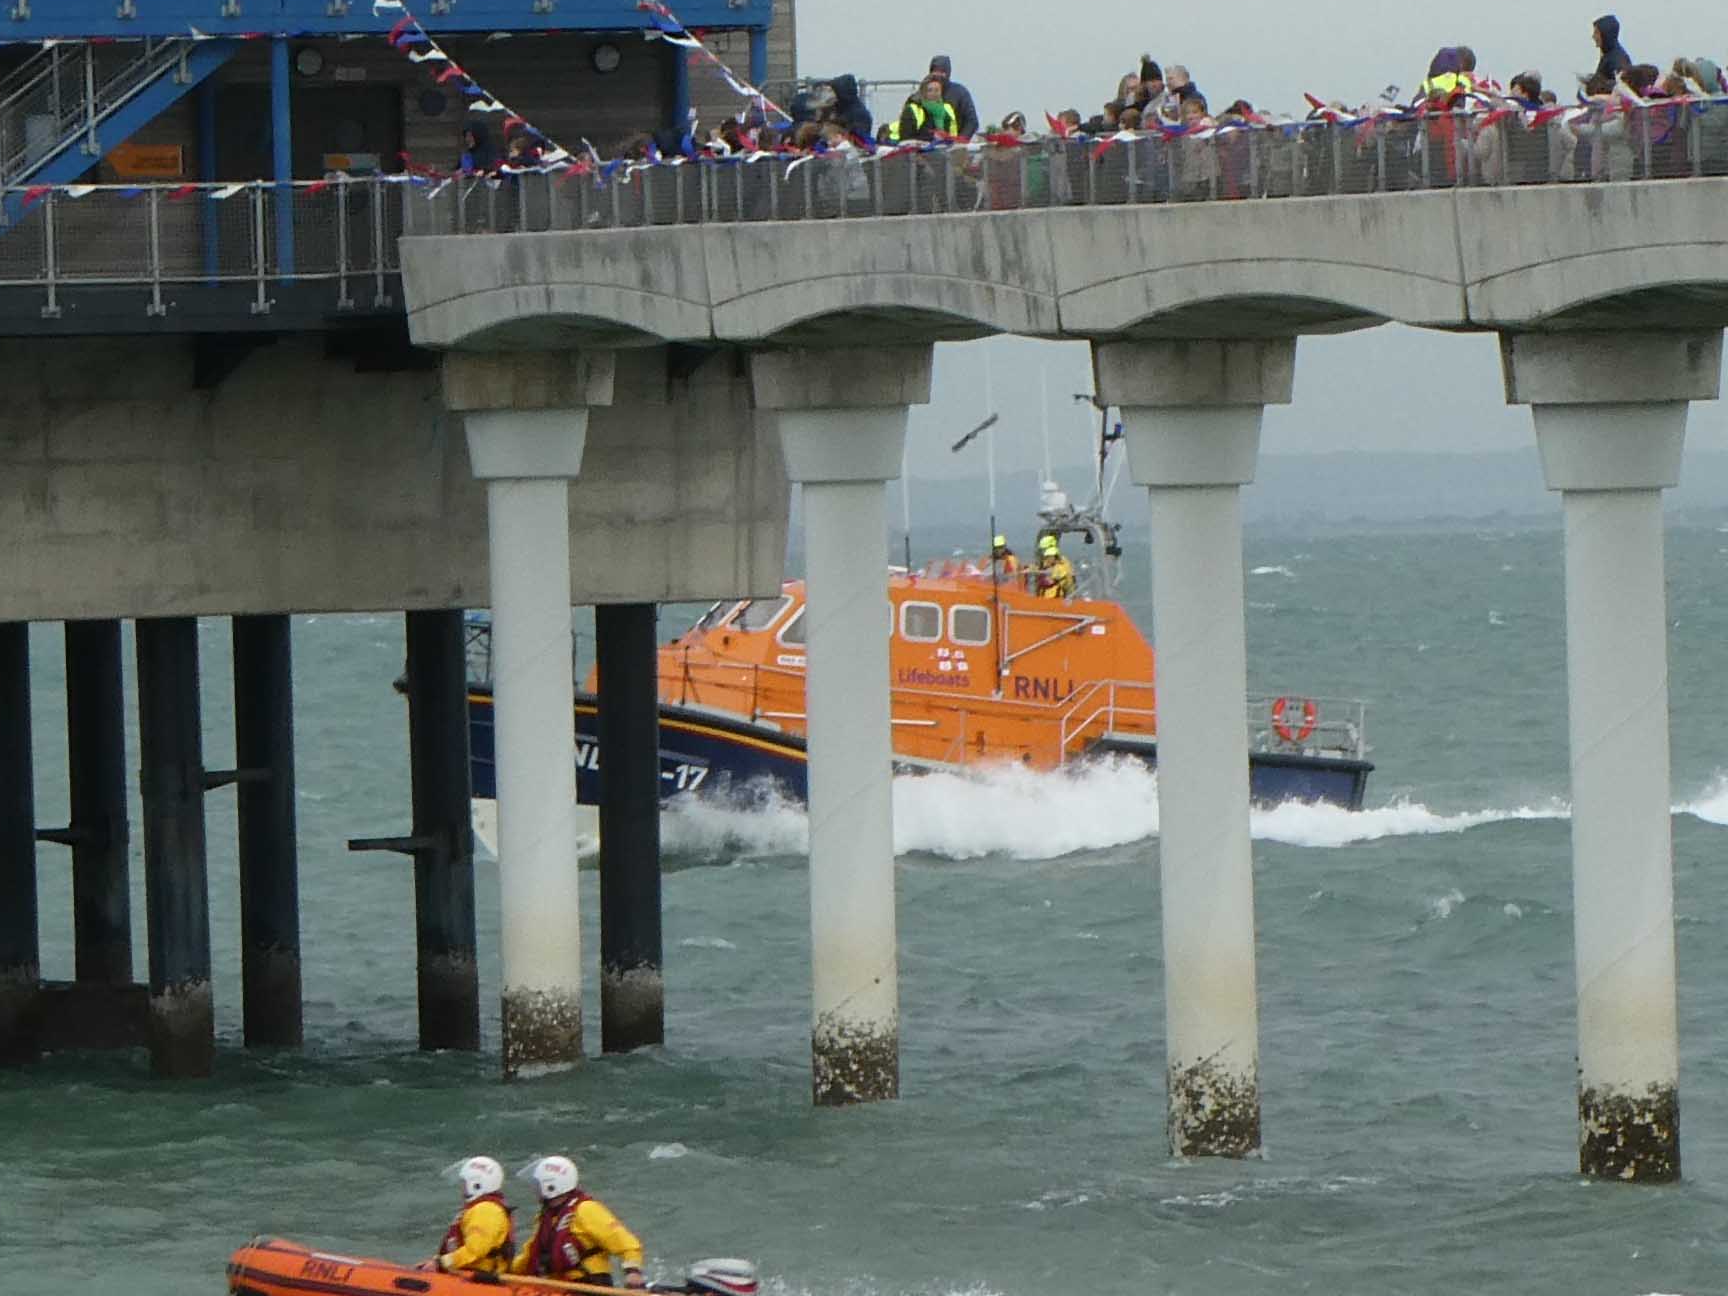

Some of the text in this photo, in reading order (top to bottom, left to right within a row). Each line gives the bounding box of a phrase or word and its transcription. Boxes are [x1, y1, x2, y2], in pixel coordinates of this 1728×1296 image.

[898, 666, 970, 688] Lifeboats
[1014, 675, 1074, 702] RNLI
[300, 1260, 354, 1283] RNLI
